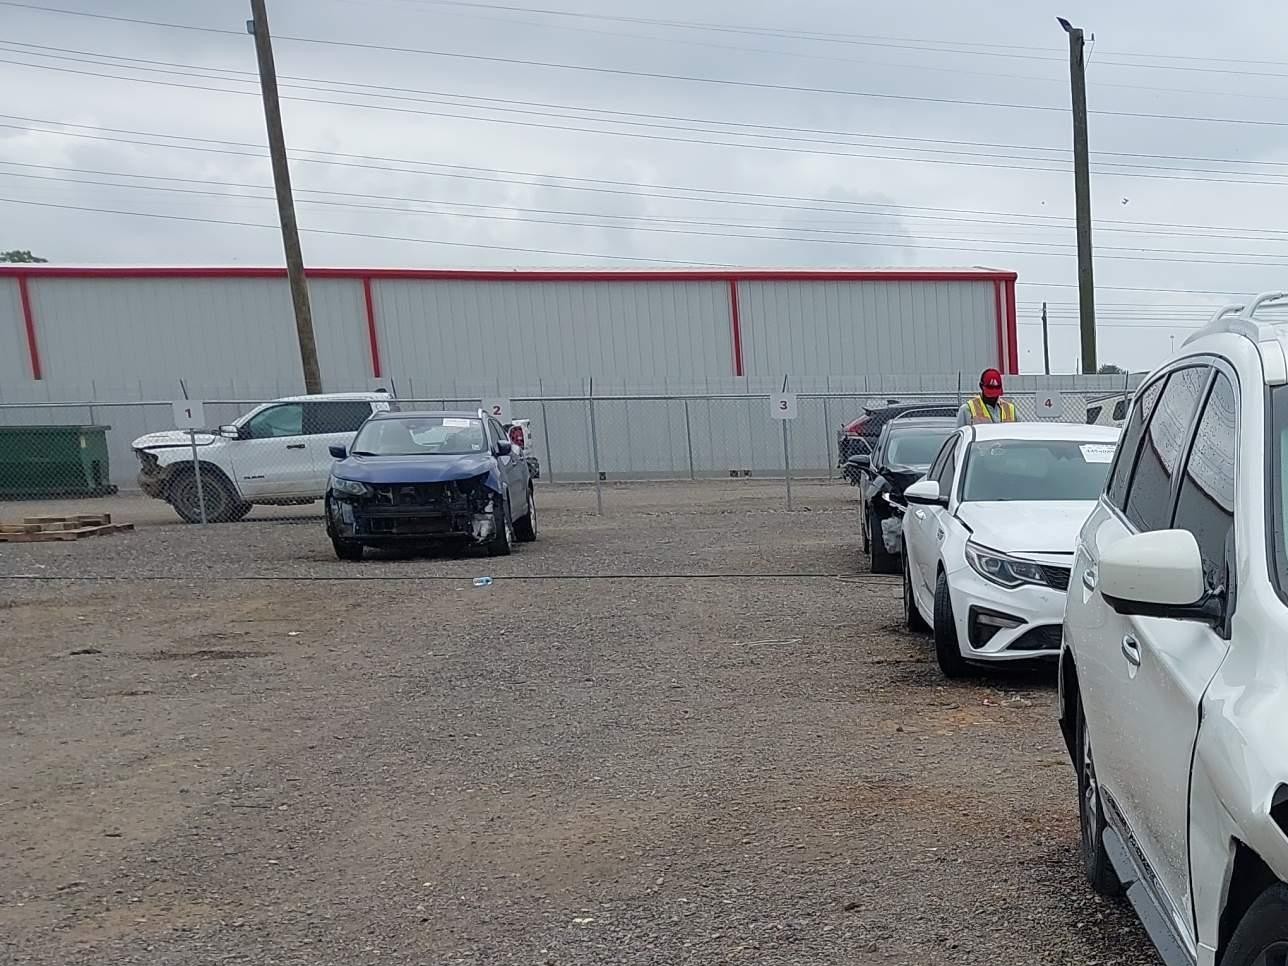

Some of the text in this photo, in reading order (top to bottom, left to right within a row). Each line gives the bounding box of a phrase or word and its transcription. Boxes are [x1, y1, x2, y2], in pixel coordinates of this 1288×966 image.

[780, 400, 788, 410] 3
[1044, 398, 1052, 408] 4
[185, 408, 192, 419] 1
[492, 406, 502, 415] 2
